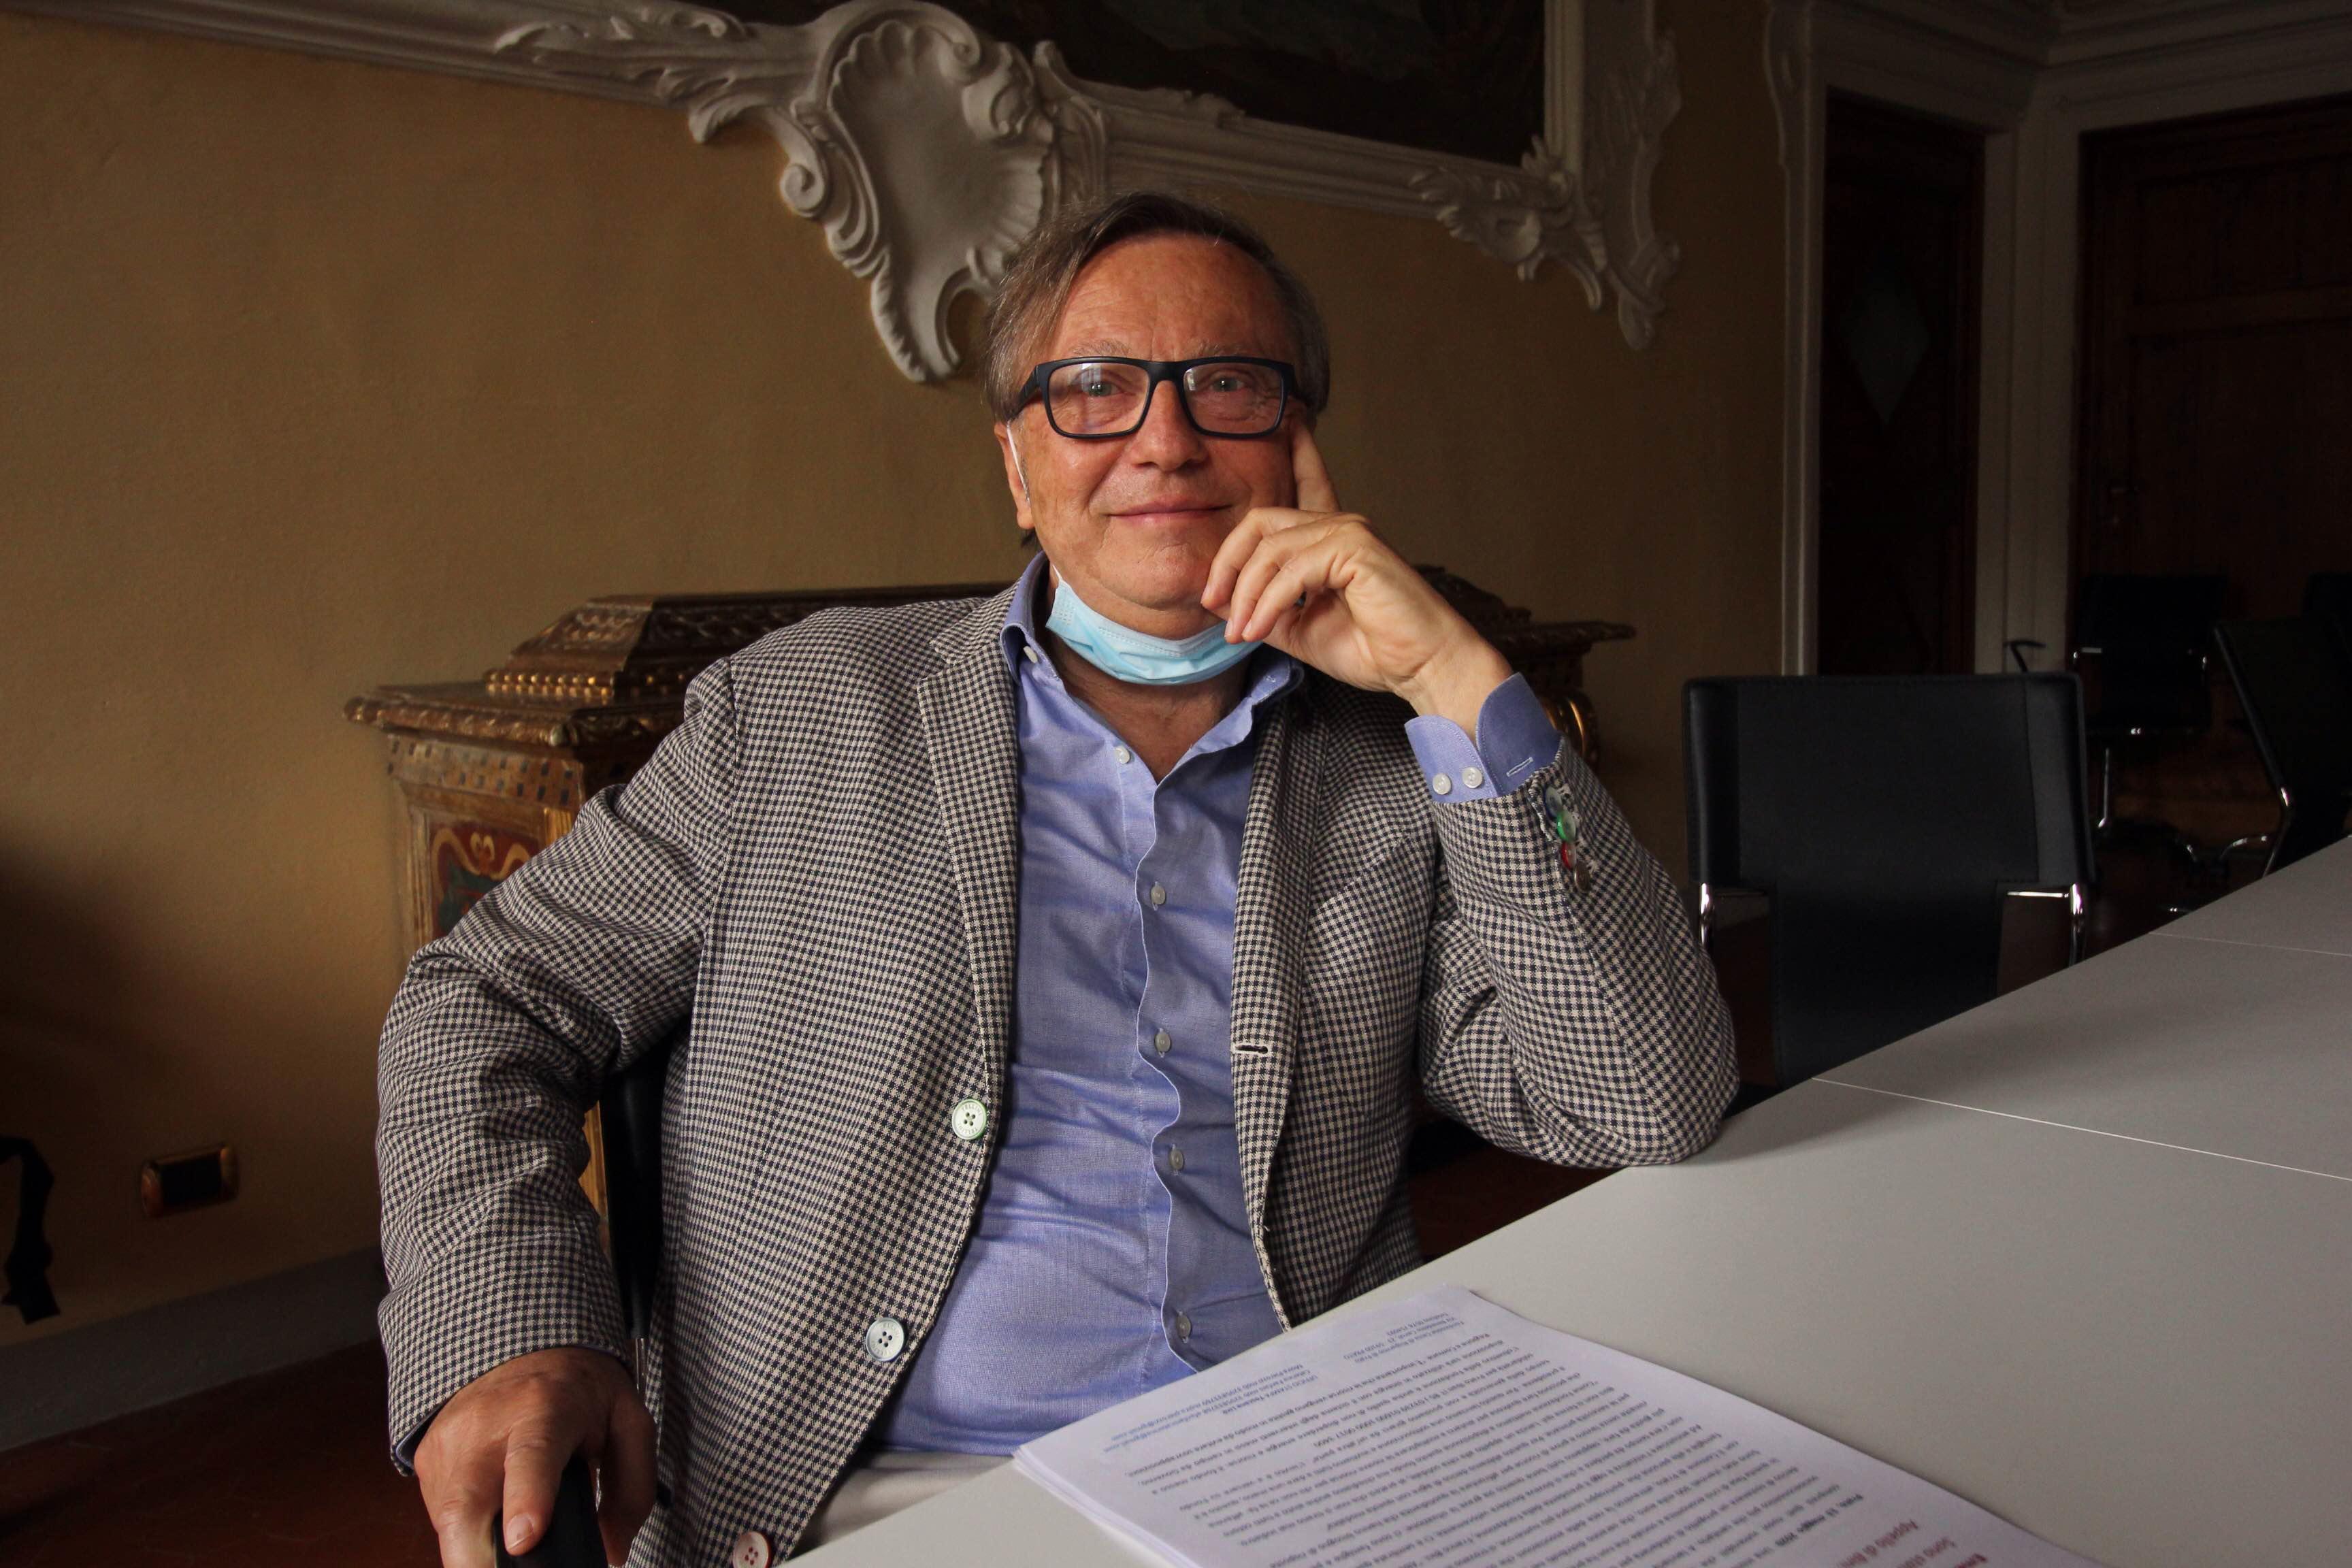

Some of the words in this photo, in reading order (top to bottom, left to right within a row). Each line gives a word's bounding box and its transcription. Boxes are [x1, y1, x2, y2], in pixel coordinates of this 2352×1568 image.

[1797, 1515, 1826, 1533] maggio
[1874, 1519, 1919, 1548] Appello
[1862, 1545, 1878, 1557] di
